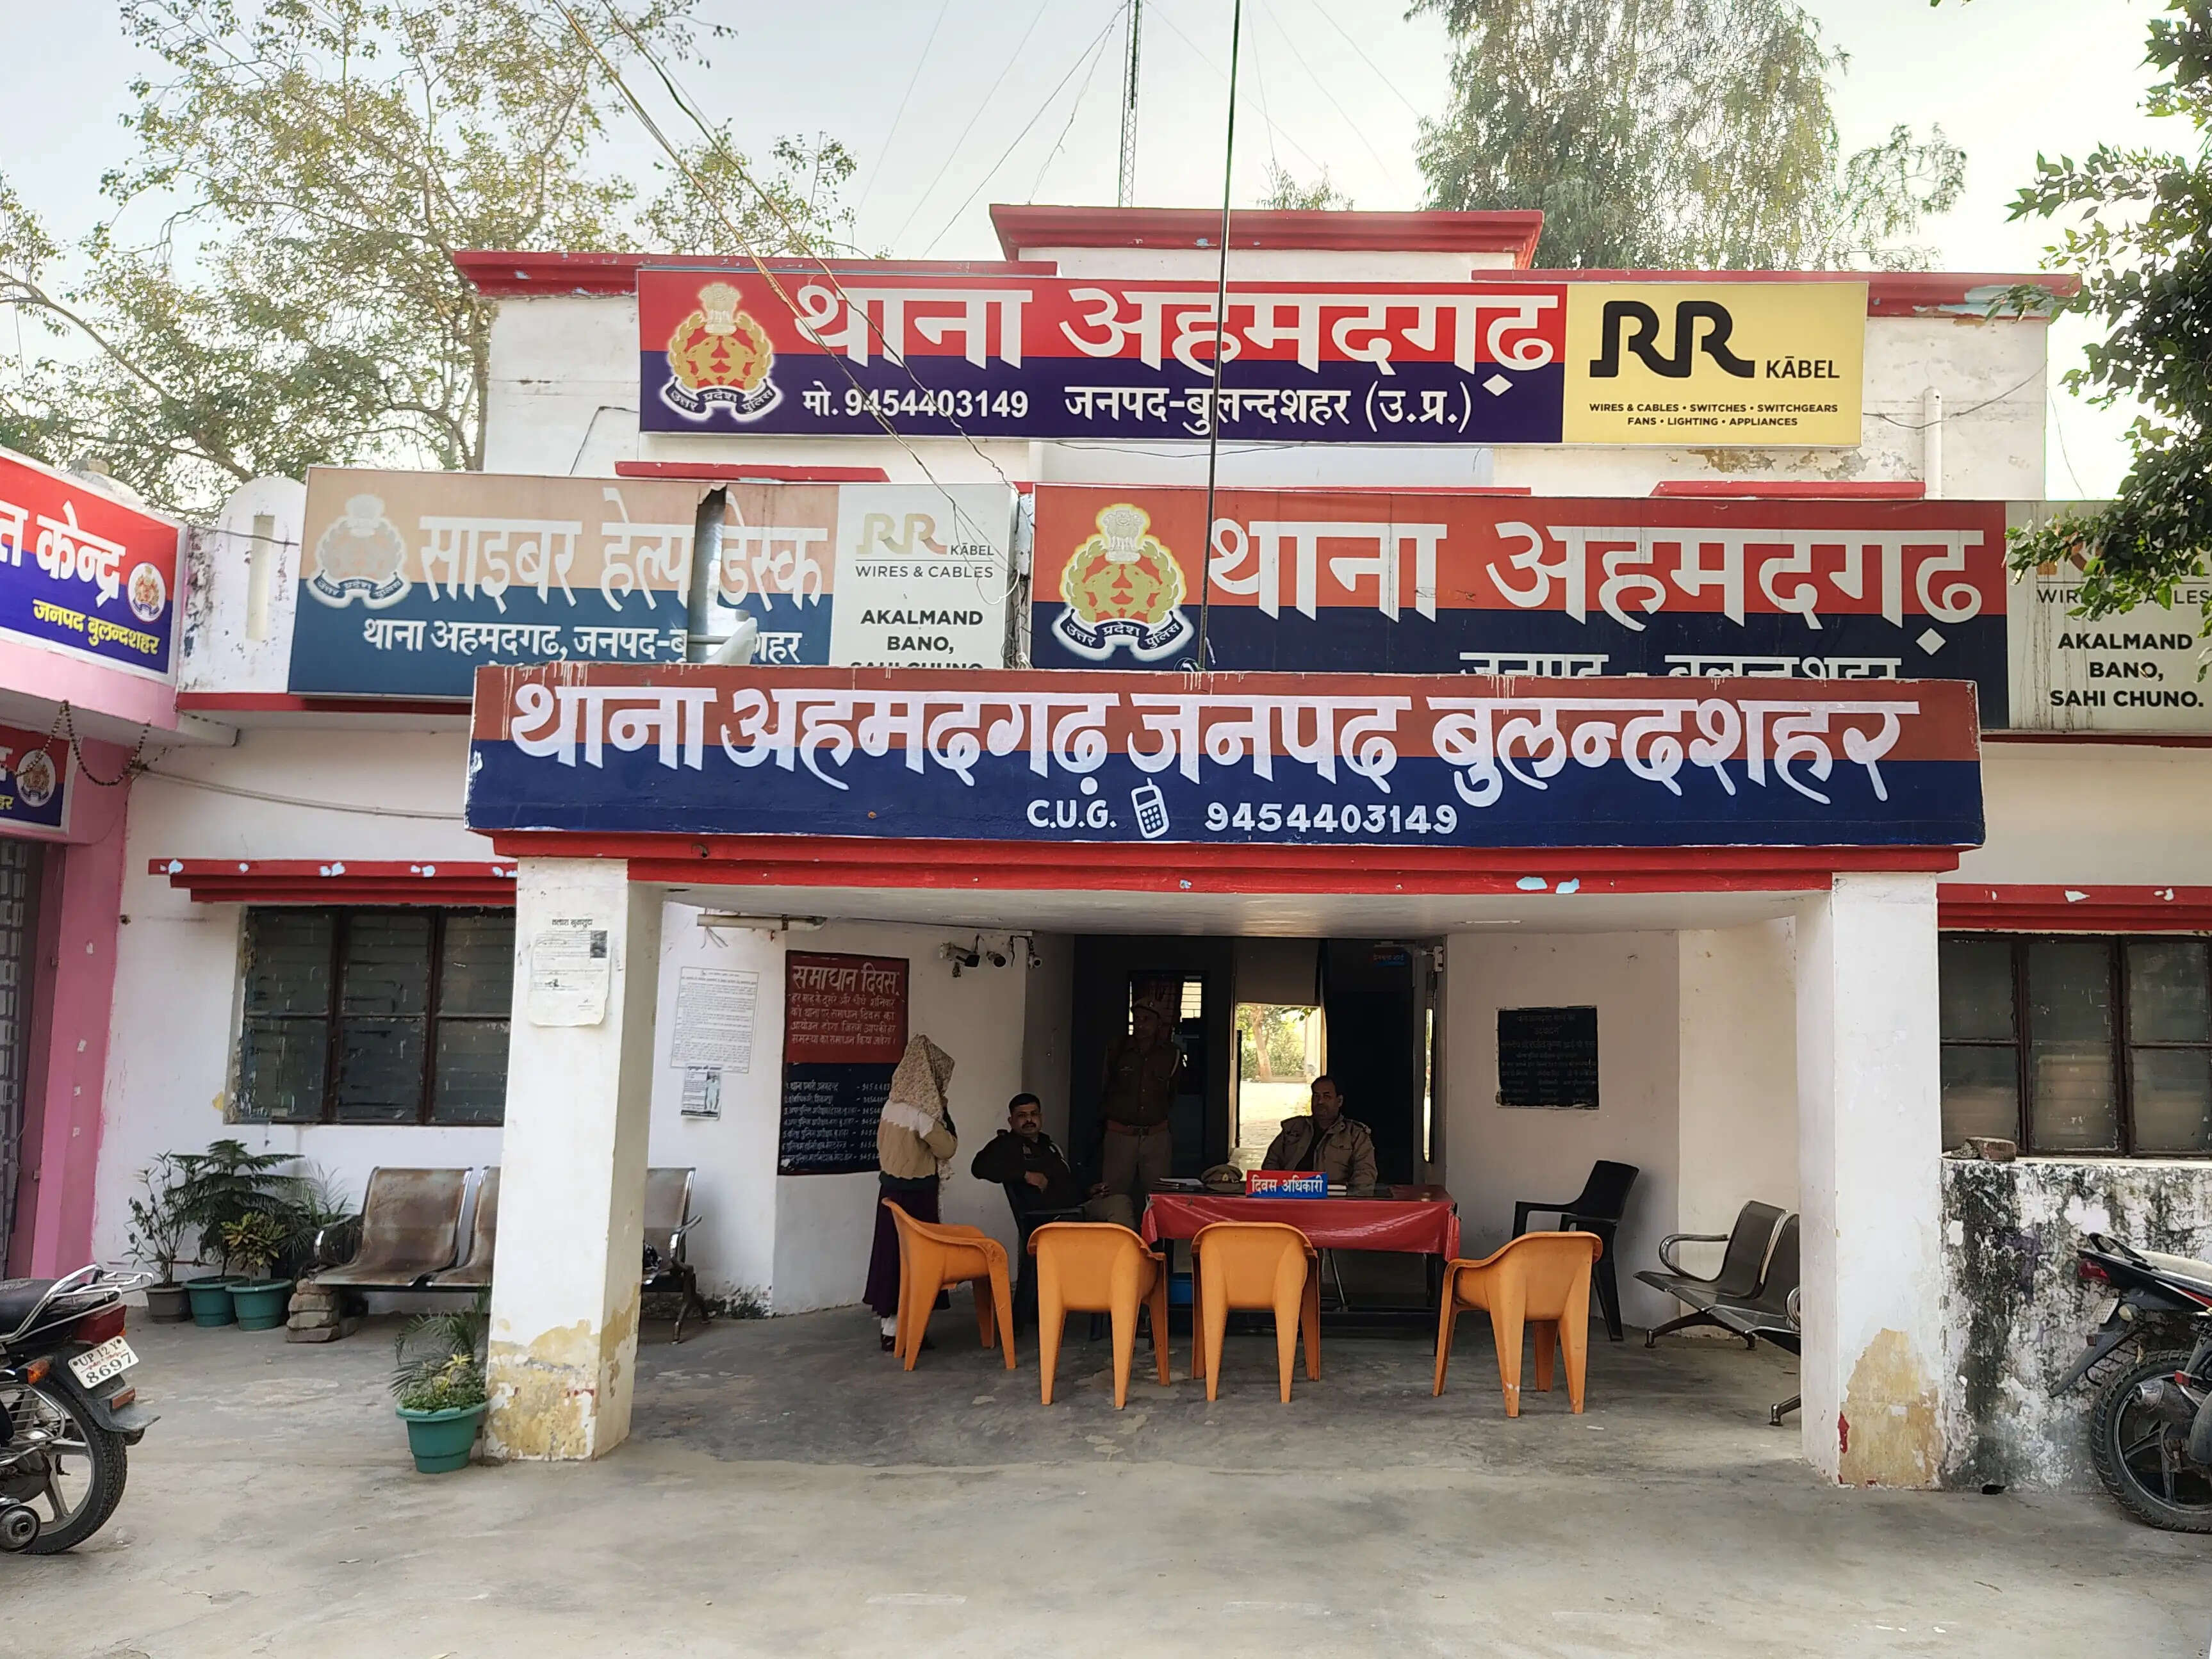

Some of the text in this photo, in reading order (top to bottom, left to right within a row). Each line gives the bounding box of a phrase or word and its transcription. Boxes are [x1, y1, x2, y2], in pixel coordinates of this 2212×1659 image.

[794, 284, 1559, 396] थाना अहमदगढ़
[1589, 300, 1755, 379] RR
[702, 389, 738, 402] प्रदेश
[741, 389, 774, 413] पुलिस
[1589, 403, 1839, 413] WIRES & CABLES SWITCHES SWITCHGEARS
[1628, 417, 1798, 427] FANS LIGHTING APPLIANCES
[855, 512, 948, 555] RR
[36, 500, 127, 609] केन्द्र
[418, 515, 582, 614] साइबर
[600, 487, 696, 612] हेल्प
[855, 566, 994, 578] WIRES & CABLES
[1208, 517, 1985, 657] थाना अहमदगढ़
[33, 598, 86, 633] जनपद
[87, 615, 161, 655] बुलन्दशहर
[860, 609, 983, 625] AKALMAND
[363, 618, 427, 651] थाना
[887, 636, 954, 655] BANO,
[1067, 621, 1180, 649] उत्तर प्रदेश पुलिस
[2058, 632, 2193, 650] AKALMAND
[2089, 662, 2165, 682] BANO,
[2050, 691, 2204, 708] SAHI CHUNO.
[511, 683, 1920, 808] थाना अहमदगढ़ जनपद बुलन्दशहर
[1026, 799, 1458, 834] C.U.G. 9454403149
[792, 965, 858, 992] समाधान
[1251, 1174, 1323, 1194] दिवस अधिकारी
[78, 1353, 94, 1366] UP
[96, 1346, 110, 1358] 12
[86, 1352, 132, 1384] 8697
